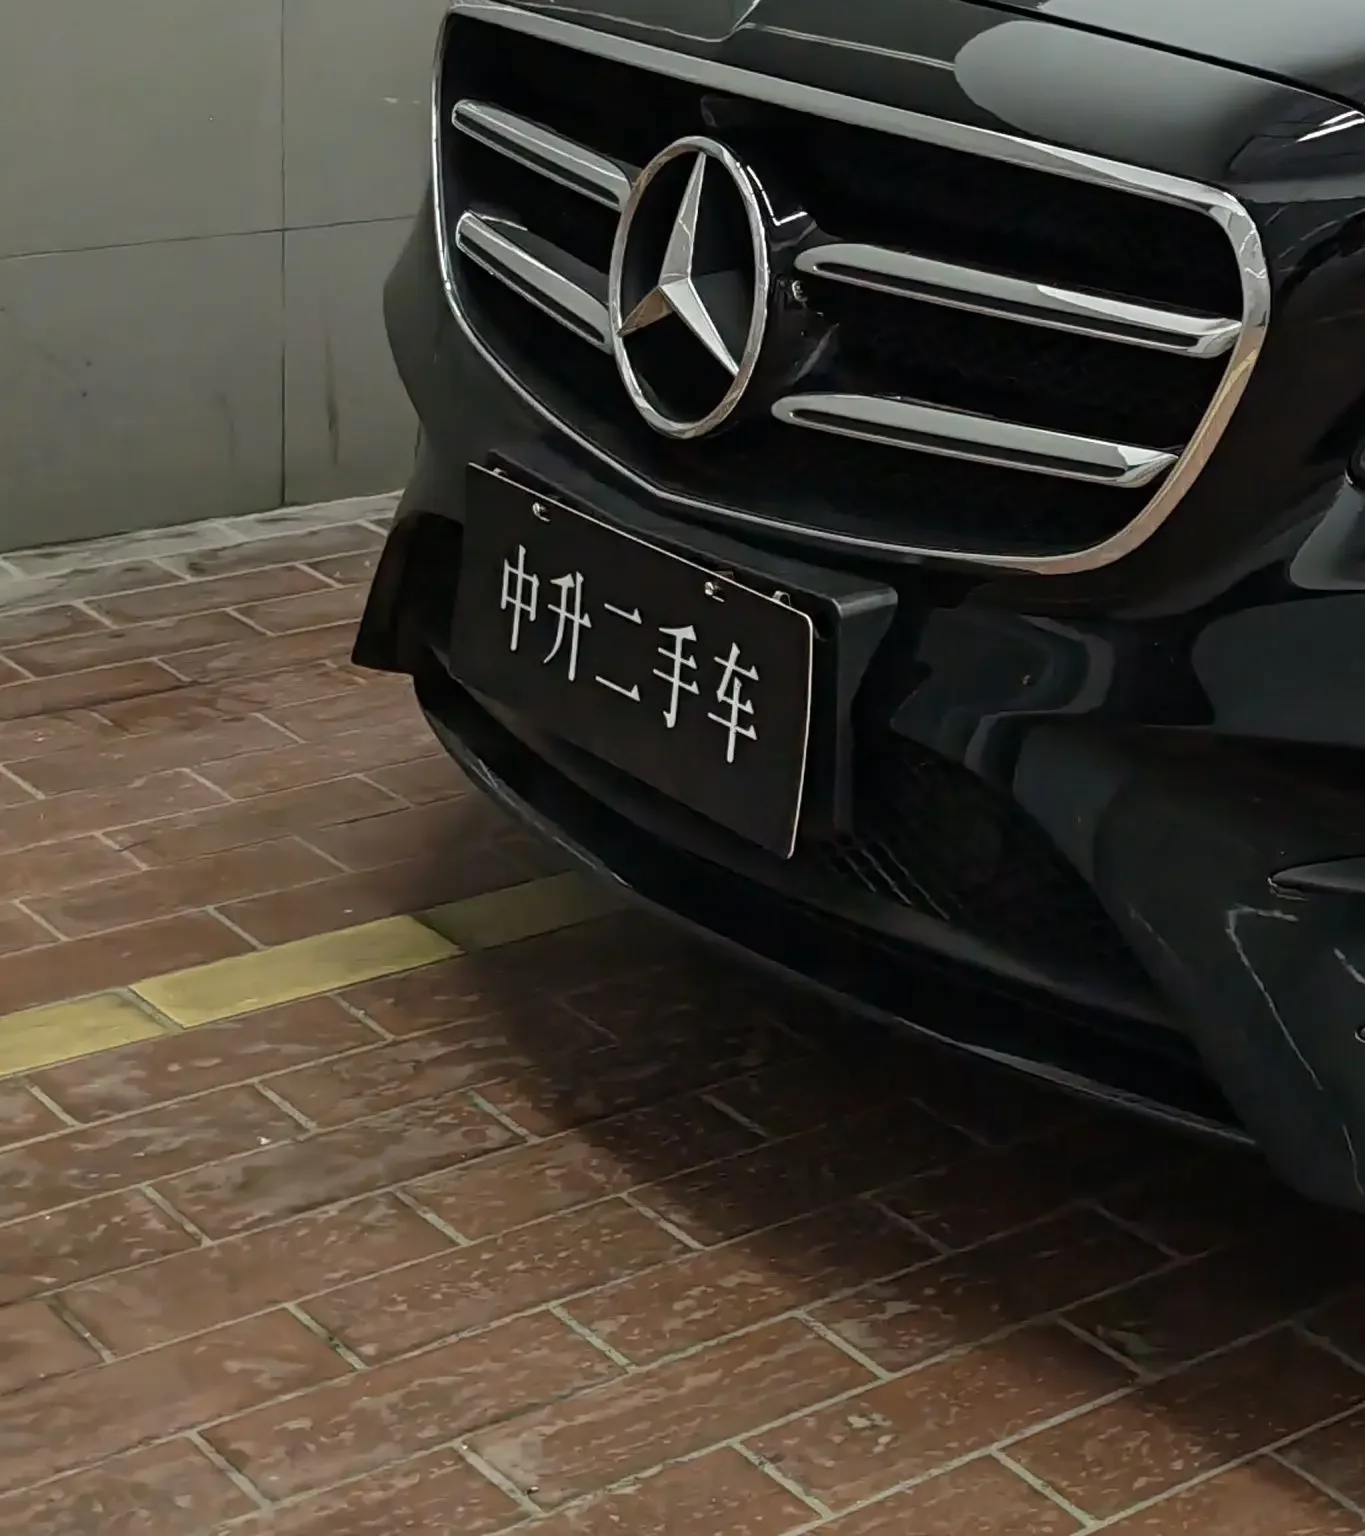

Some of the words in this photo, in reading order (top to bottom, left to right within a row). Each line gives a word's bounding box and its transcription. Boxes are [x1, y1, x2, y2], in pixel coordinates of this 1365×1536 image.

[497, 543, 761, 765] 中升二手车
